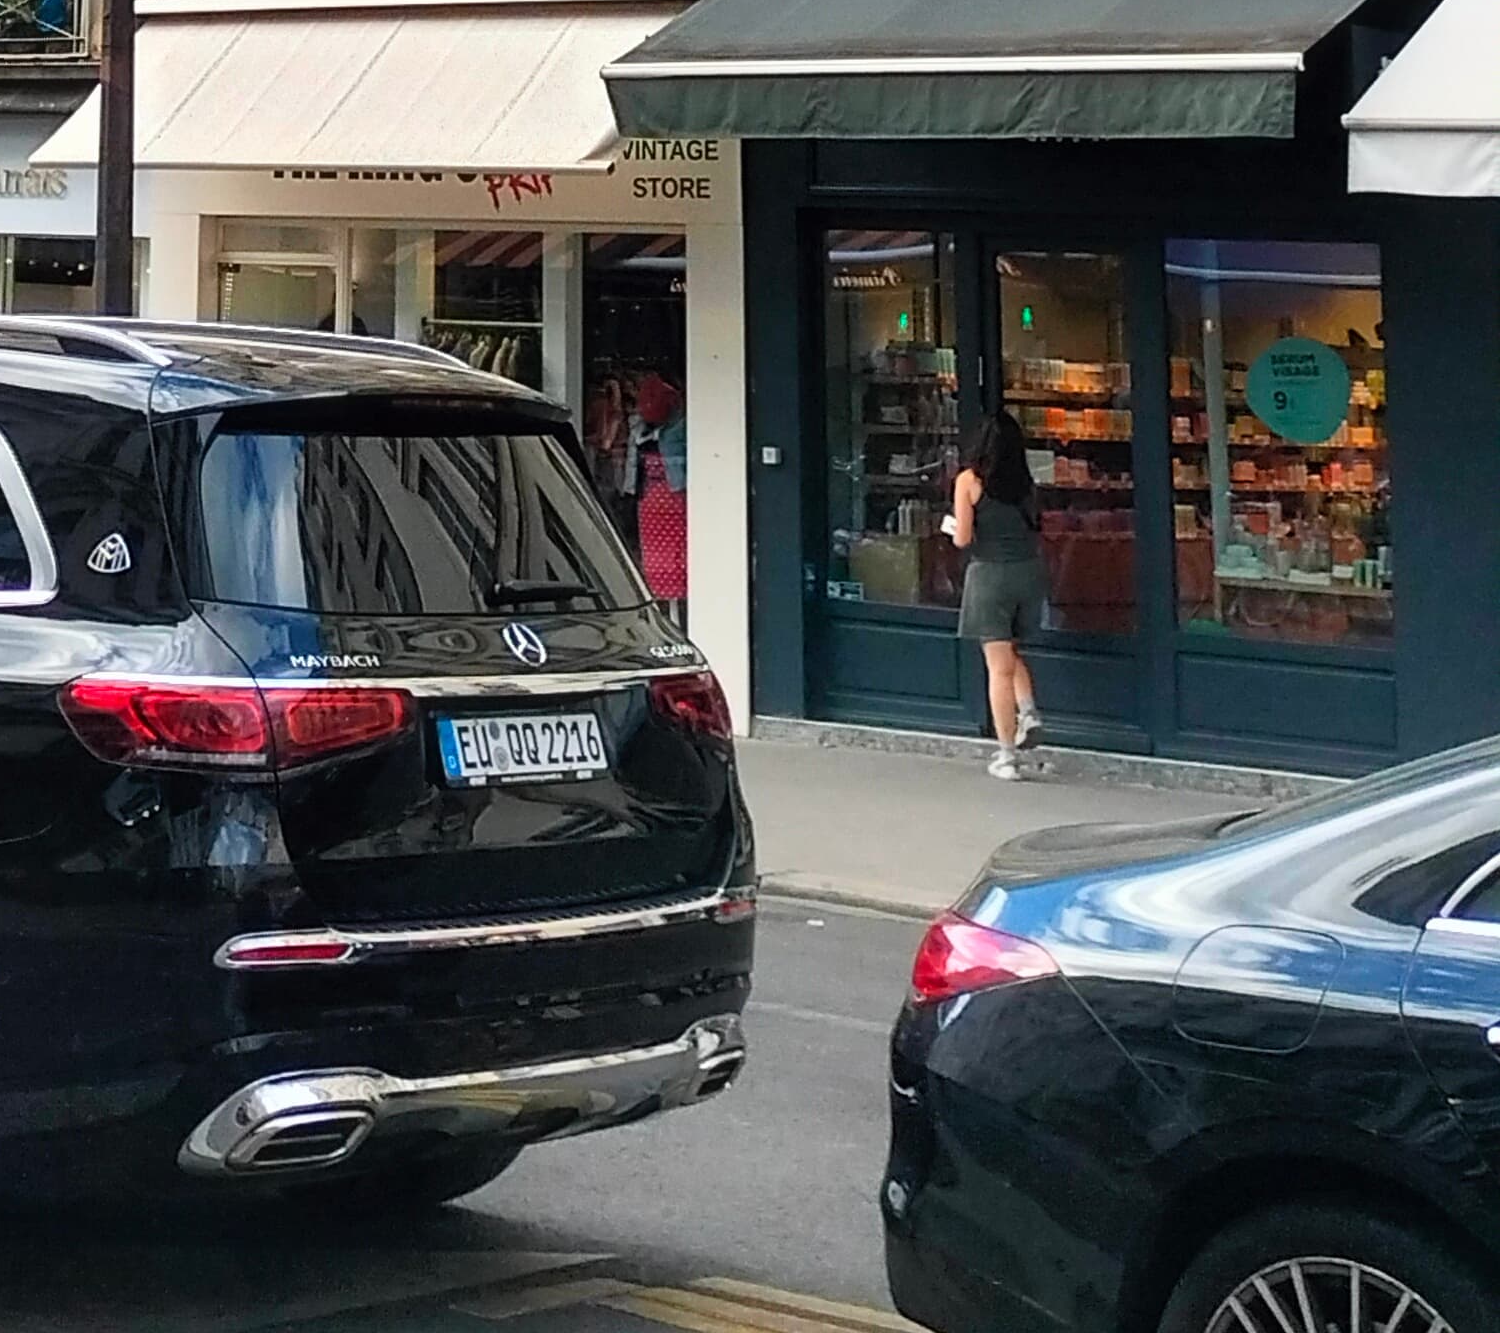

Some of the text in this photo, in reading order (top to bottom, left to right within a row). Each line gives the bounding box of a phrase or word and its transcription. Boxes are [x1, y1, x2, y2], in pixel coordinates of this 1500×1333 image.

[622, 139, 719, 161] VINTAGE
[632, 176, 712, 200] STORE
[289, 654, 381, 668] MAYBACH
[456, 724, 493, 769] EU
[541, 719, 601, 764] 2216
